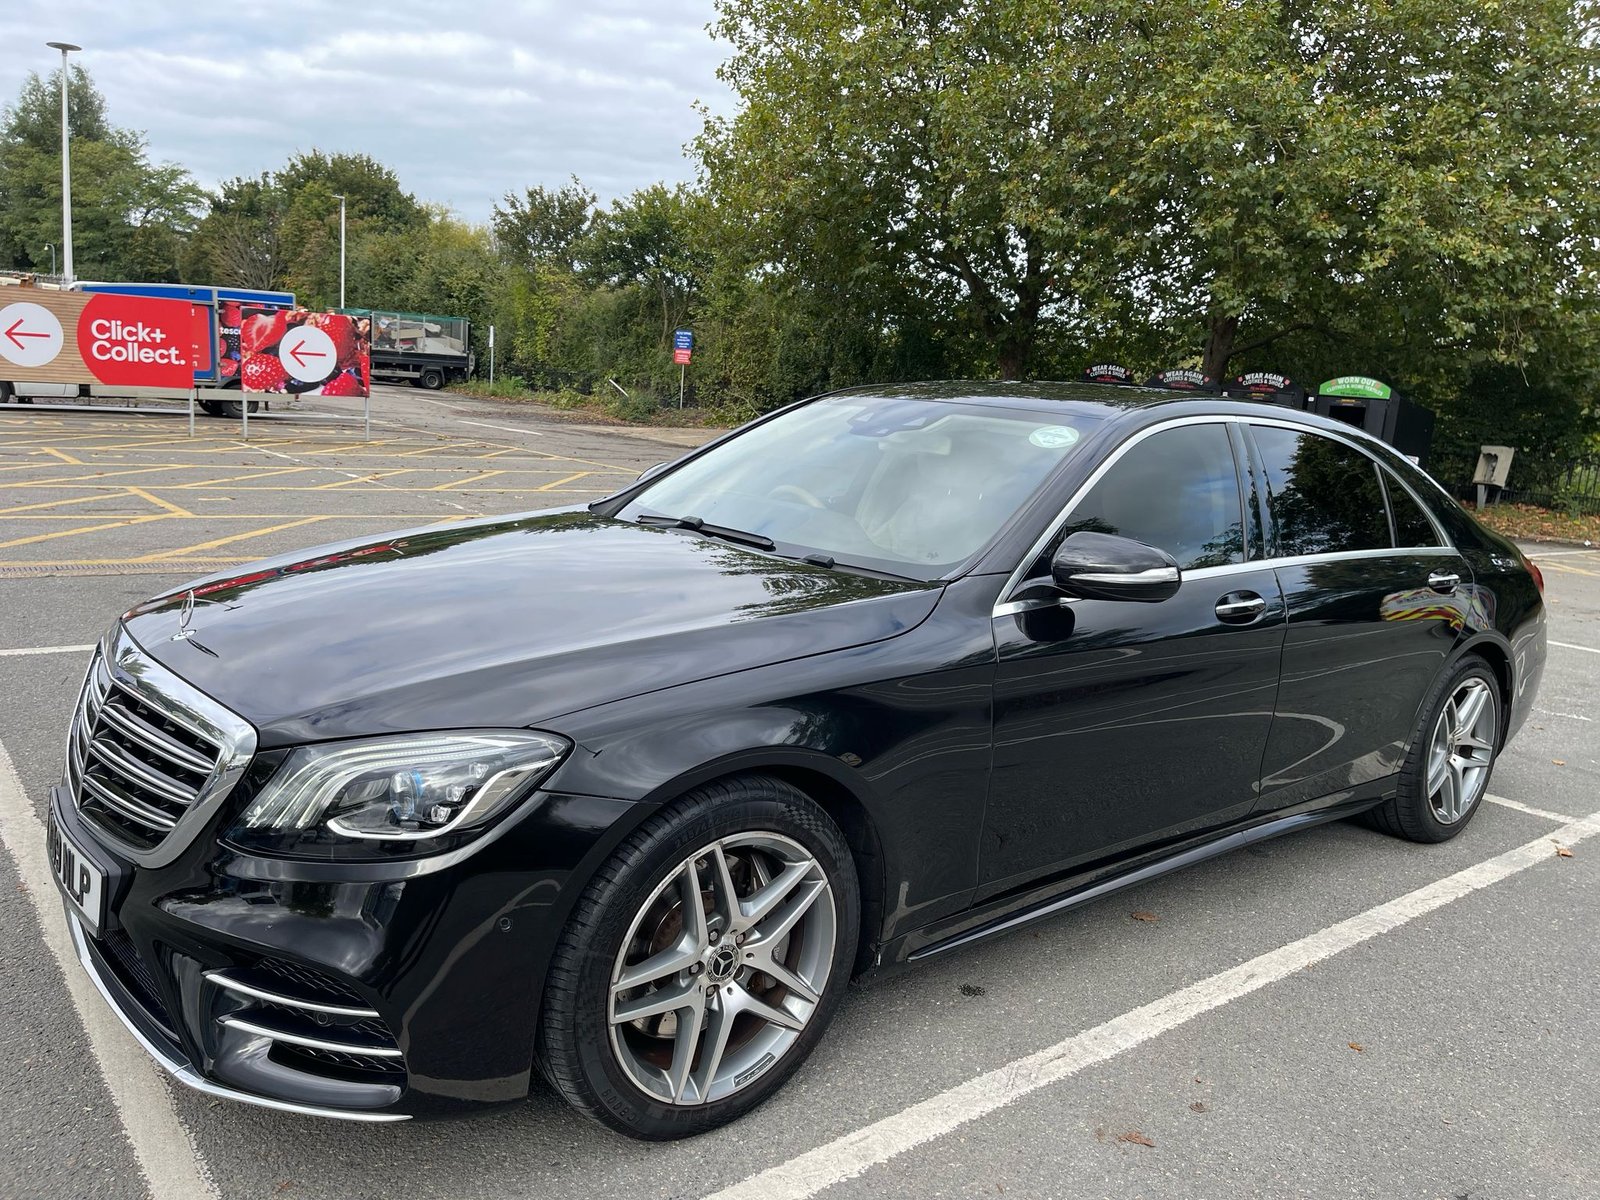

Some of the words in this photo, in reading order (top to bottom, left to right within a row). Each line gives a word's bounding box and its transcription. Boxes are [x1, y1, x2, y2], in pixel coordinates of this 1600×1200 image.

[91, 319, 166, 343] Click+
[91, 340, 186, 365] Collect.
[1108, 365, 1125, 374] AGAIN
[1165, 370, 1183, 378] WEAR
[1184, 370, 1203, 380] AGAIN
[1245, 372, 1263, 380] WEAR
[1264, 373, 1284, 383] AGAIN
[1361, 377, 1377, 386] OUT
